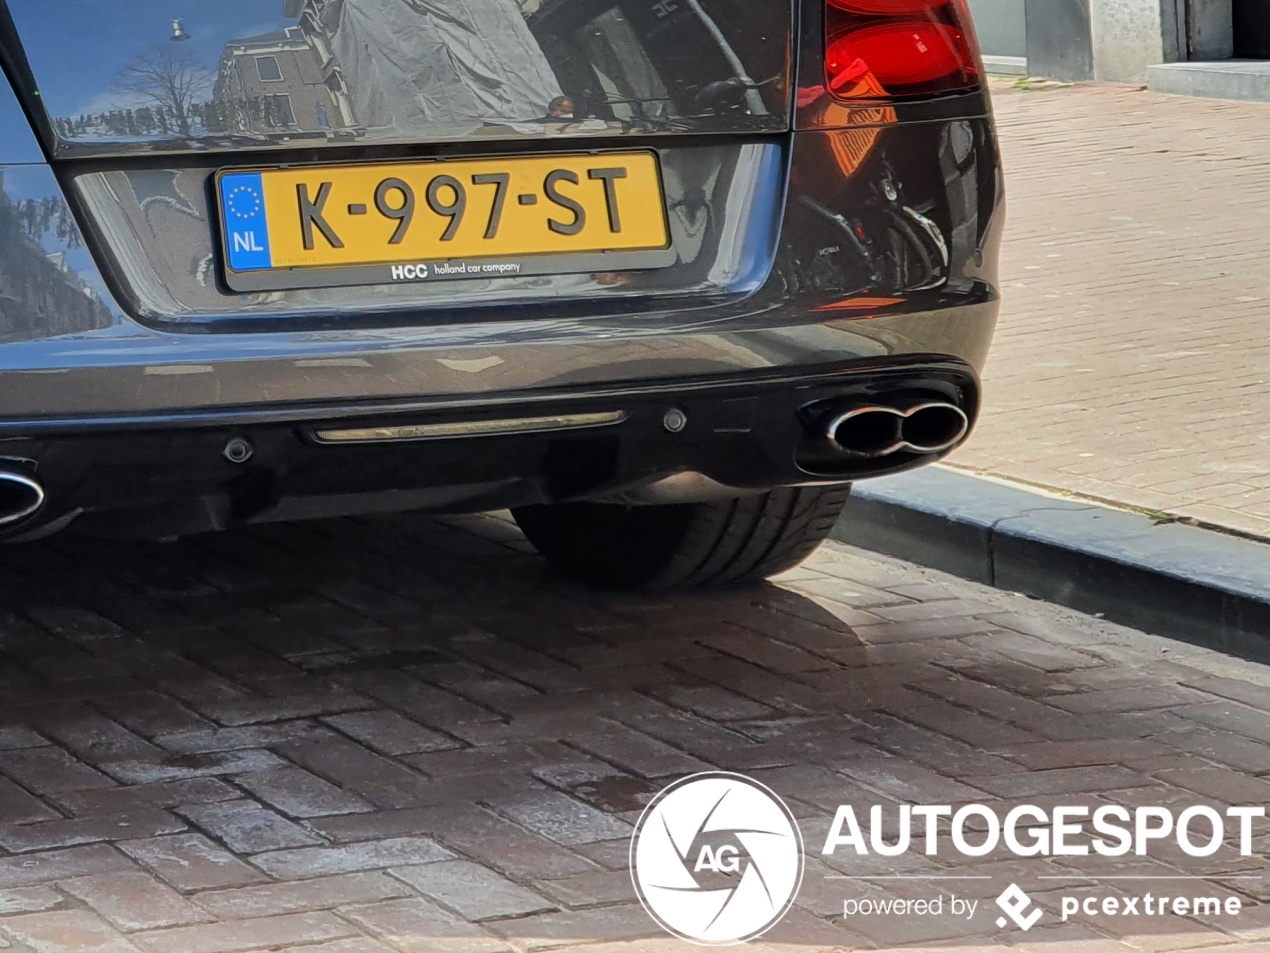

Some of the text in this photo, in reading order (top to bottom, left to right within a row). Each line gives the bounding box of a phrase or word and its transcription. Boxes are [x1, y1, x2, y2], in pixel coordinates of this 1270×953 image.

[296, 167, 628, 251] K-997-ST
[233, 231, 264, 252] NL
[391, 263, 521, 280] HCC holland car company
